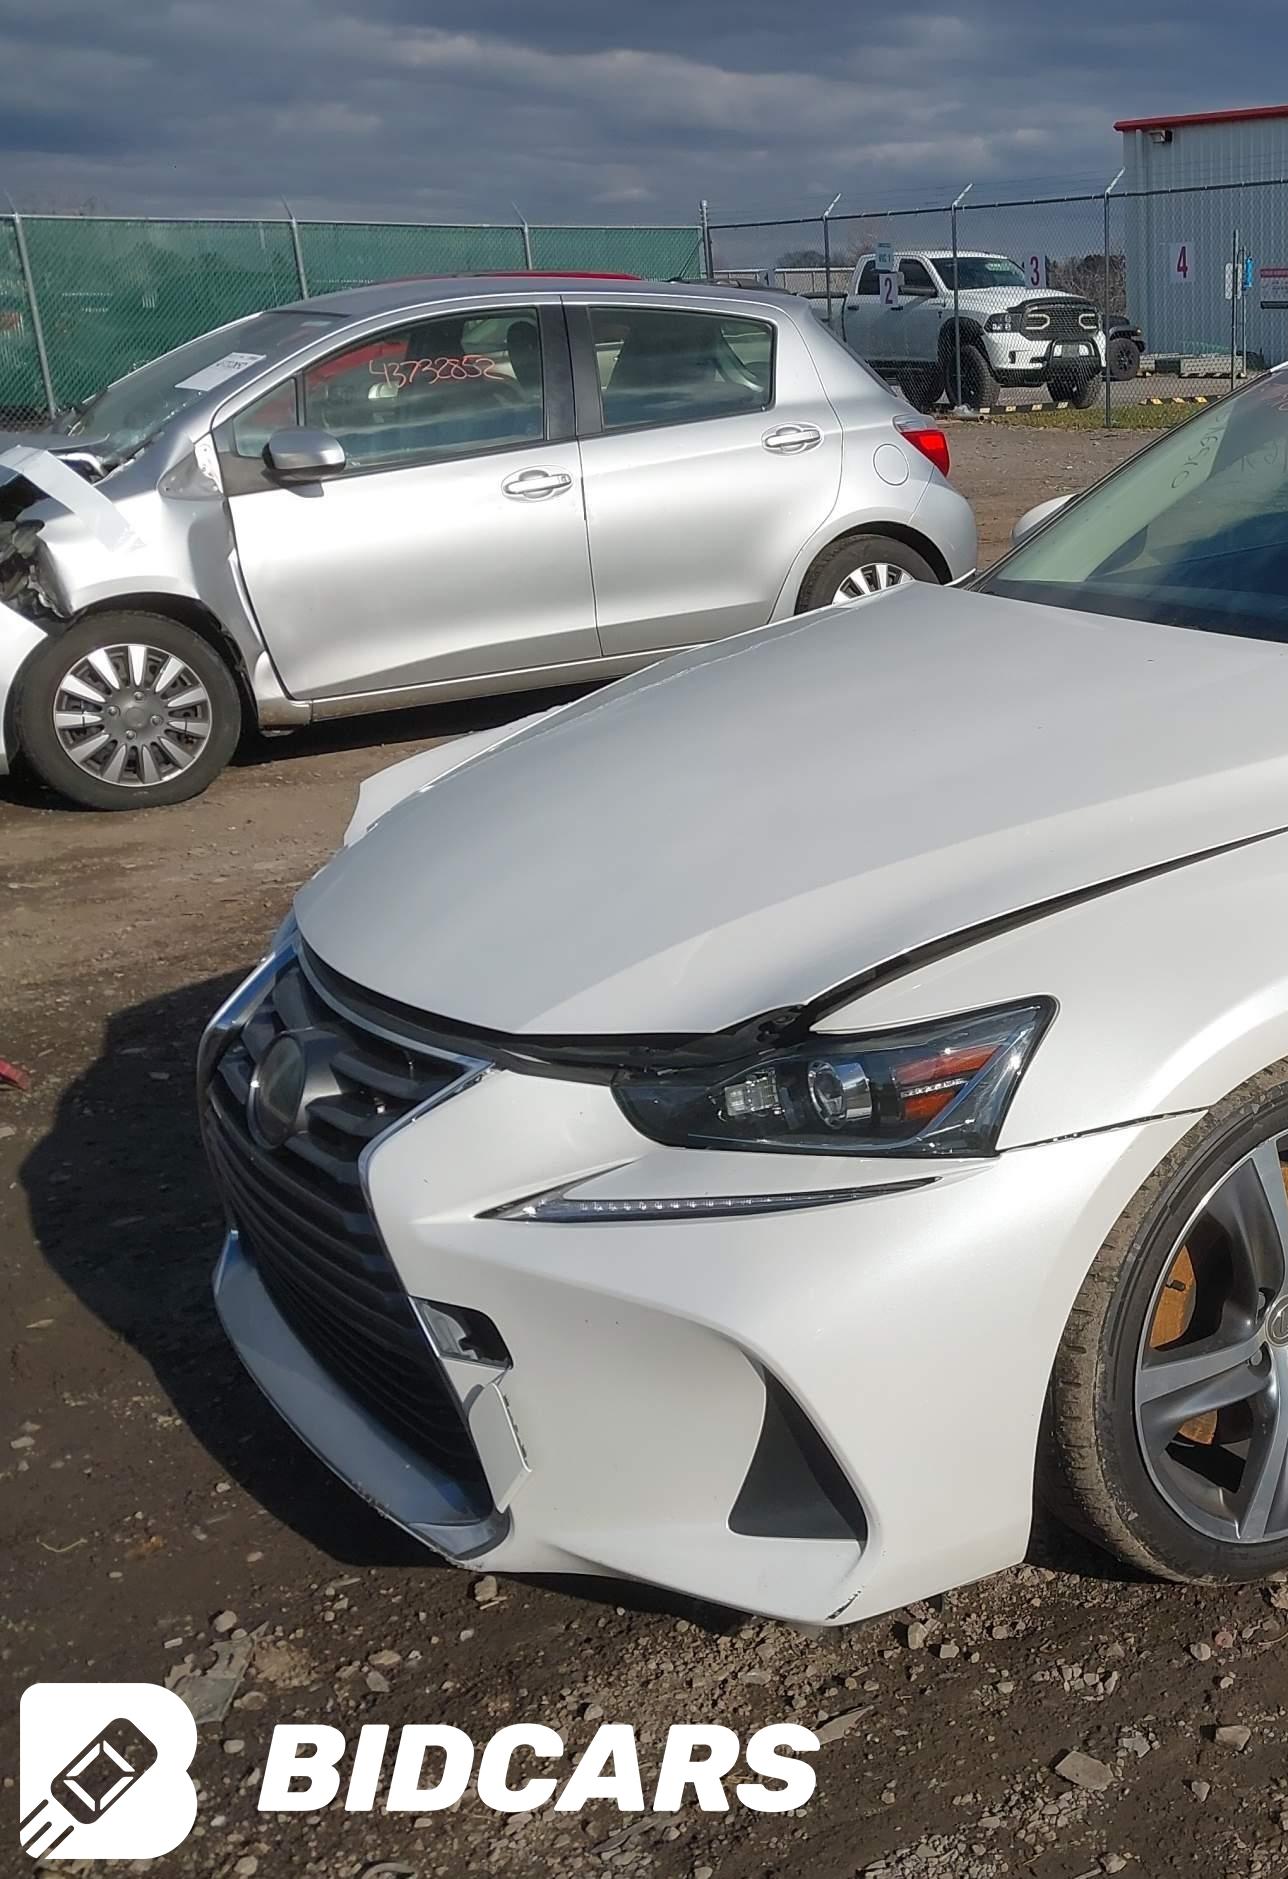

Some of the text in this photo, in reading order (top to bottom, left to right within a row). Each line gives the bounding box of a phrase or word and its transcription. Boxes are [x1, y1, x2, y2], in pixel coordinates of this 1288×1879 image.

[1030, 256, 1040, 286] 3
[1177, 246, 1188, 279] 4
[884, 277, 893, 305] 2
